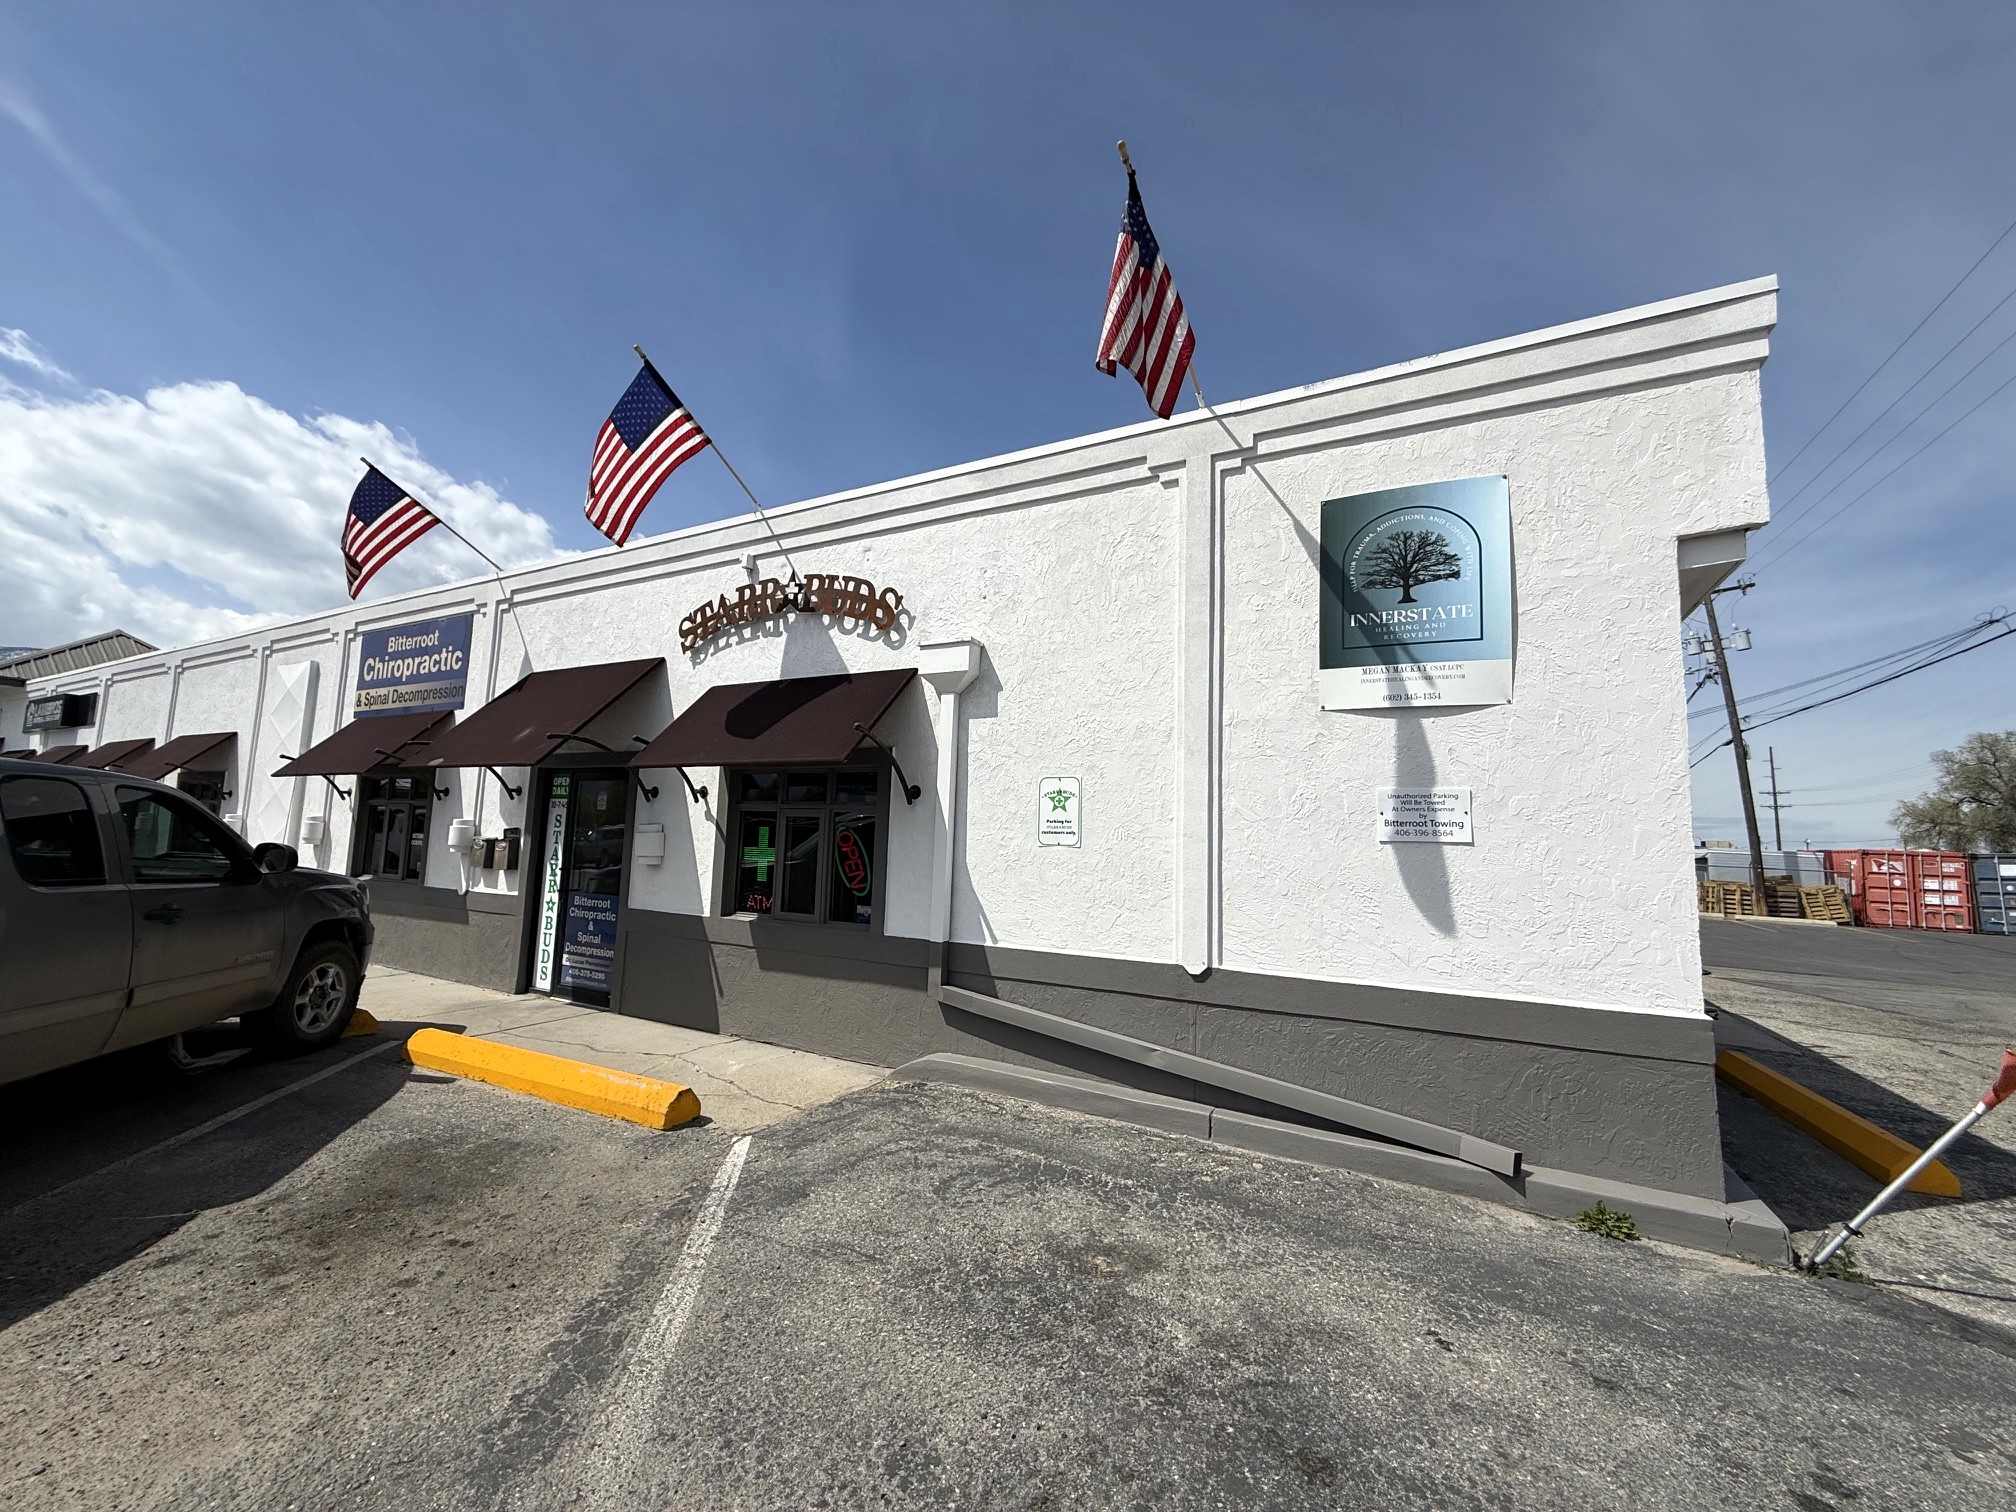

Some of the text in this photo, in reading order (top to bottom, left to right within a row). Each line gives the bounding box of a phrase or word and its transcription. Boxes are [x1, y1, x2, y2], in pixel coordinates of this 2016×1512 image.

[1428, 515, 1445, 525] AND
[1446, 522, 1468, 545] COPING
[679, 574, 904, 655] STARR BUDS
[1350, 604, 1474, 627] INNERSTATE
[1375, 624, 1419, 633] HEALING
[1384, 631, 1437, 640] RECOVERY
[387, 630, 440, 653] Bitterroot
[363, 646, 463, 681] Chiropractic
[1362, 666, 1390, 676] MEGAN
[1392, 664, 1428, 674] MACKAY
[356, 683, 464, 709] & Spinal Decompression
[1383, 693, 1402, 702] (602)
[1433, 793, 1459, 801] Parking
[1384, 820, 1464, 829] Bitterroot Towing
[1394, 829, 1454, 837] 406-396-8564
[547, 813, 562, 894] STARR
[836, 831, 867, 889] OPEN
[574, 896, 611, 909] Bitterroot
[747, 894, 774, 910] ATM
[569, 907, 616, 921] Chiropractic
[588, 921, 594, 931] &
[577, 932, 602, 944] Spinal
[540, 916, 553, 981] BUDS
[565, 942, 615, 958] Decompression
